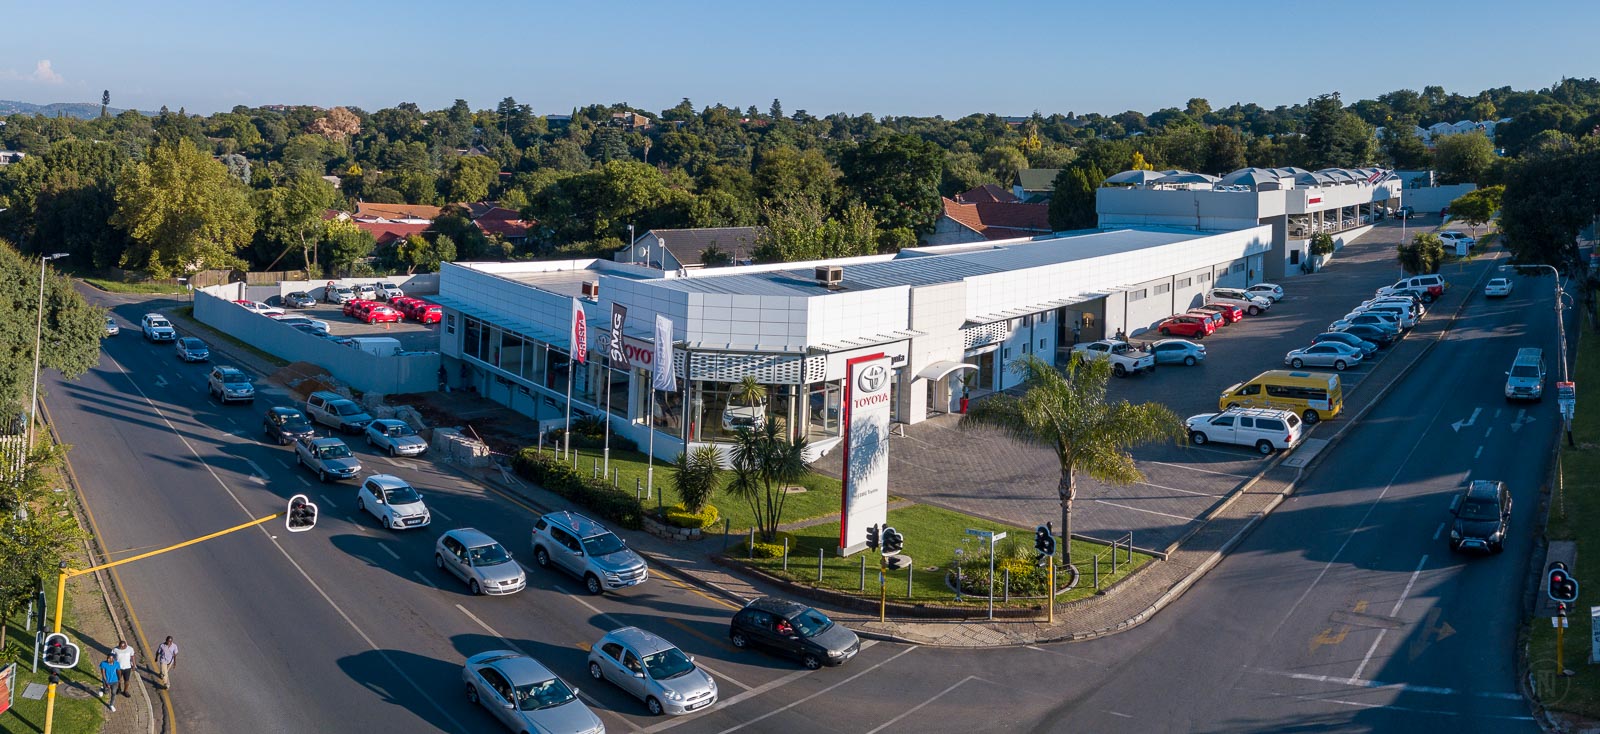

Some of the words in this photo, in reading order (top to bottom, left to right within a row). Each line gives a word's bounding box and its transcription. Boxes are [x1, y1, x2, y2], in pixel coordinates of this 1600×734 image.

[611, 313, 622, 362] SMG
[624, 344, 654, 365] OYO
[891, 354, 905, 366] yota
[854, 393, 888, 409] TOYOTA
